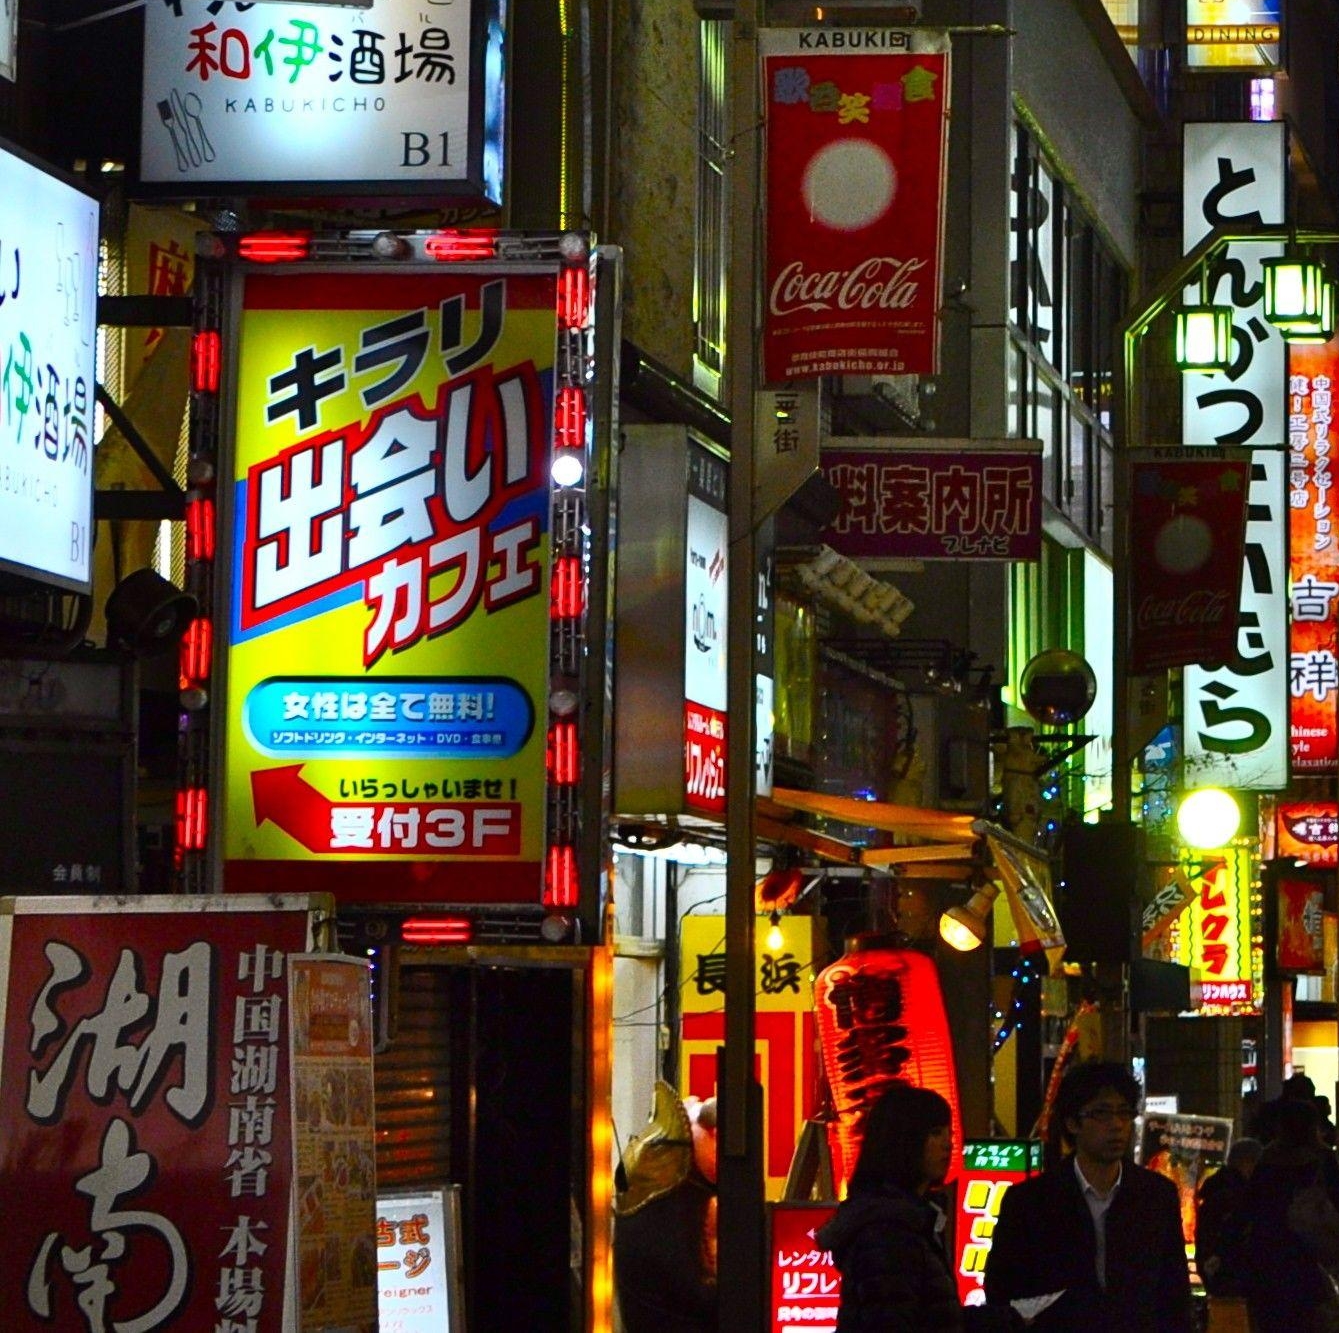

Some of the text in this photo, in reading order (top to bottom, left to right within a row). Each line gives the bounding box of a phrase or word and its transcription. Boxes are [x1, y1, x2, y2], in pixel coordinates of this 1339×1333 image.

[186, 19, 456, 85] 和伊酒場
[1193, 26, 1275, 42] DINING
[225, 96, 386, 113] KABUKICHO
[401, 132, 453, 167] B1
[769, 257, 930, 316] Coca-Cola
[265, 279, 506, 430] キラリ
[254, 375, 528, 610] 出会い
[366, 524, 537, 665] カフェ
[283, 691, 494, 722] 女性は全て無料!
[330, 807, 512, 849] 受付3F
[223, 943, 284, 1197] 中国湖南省
